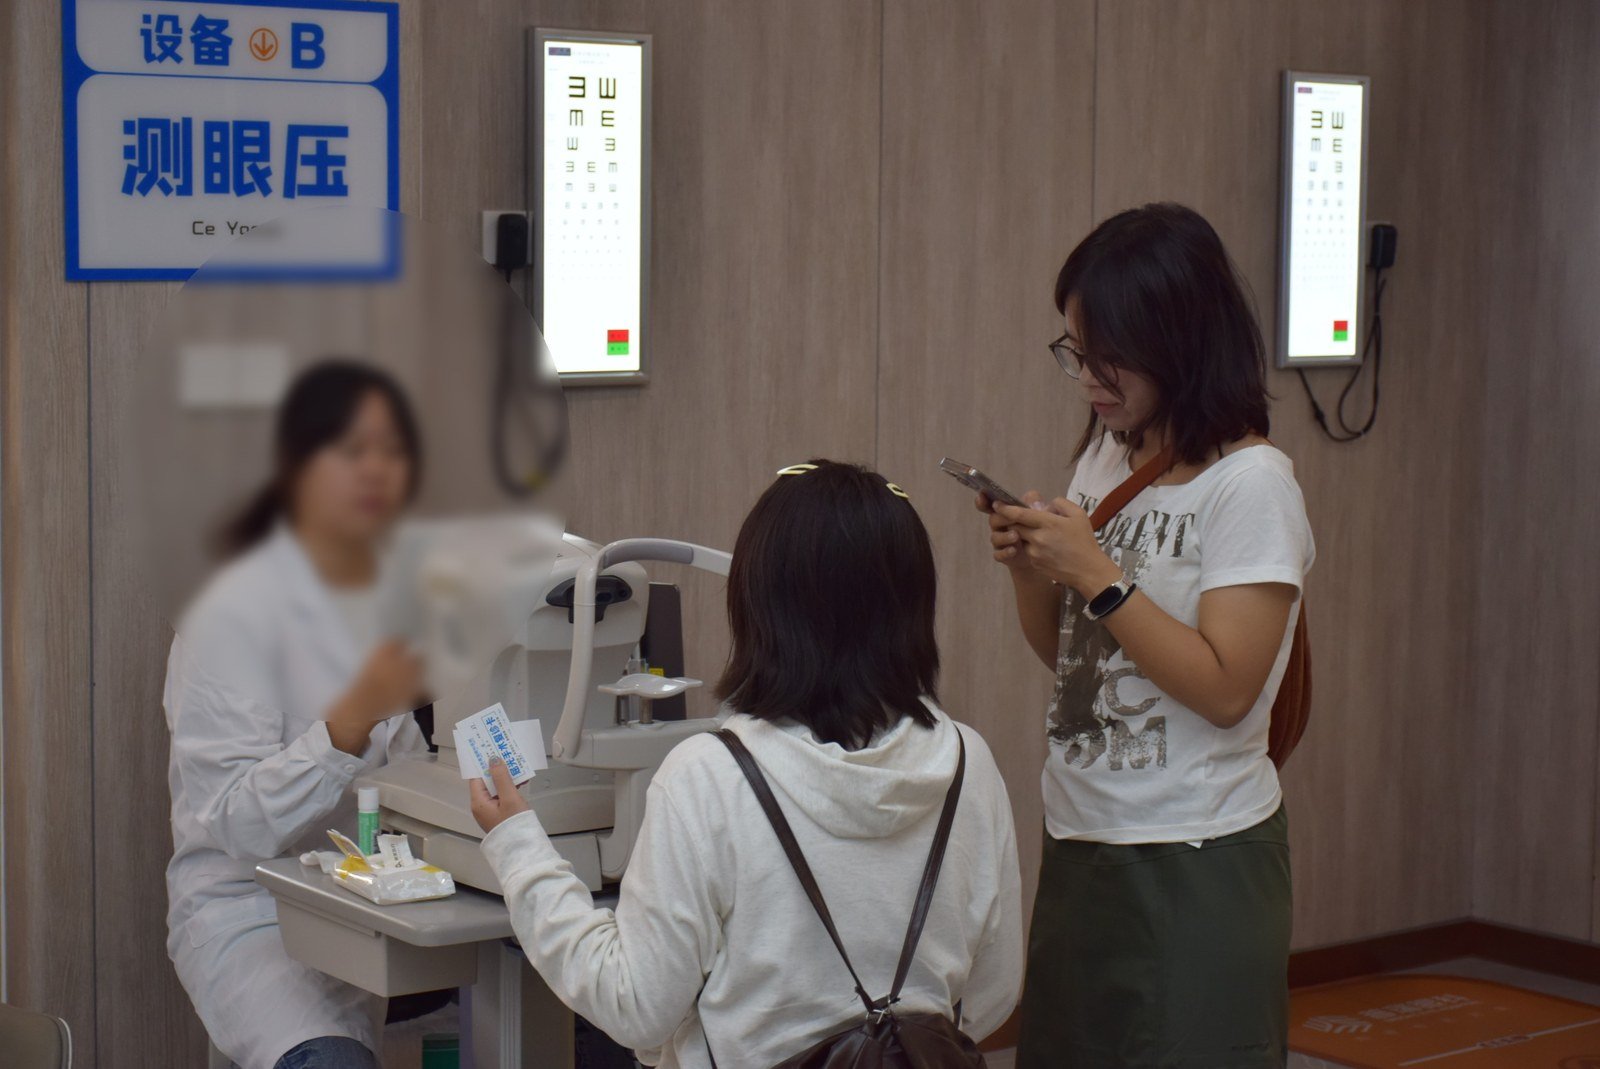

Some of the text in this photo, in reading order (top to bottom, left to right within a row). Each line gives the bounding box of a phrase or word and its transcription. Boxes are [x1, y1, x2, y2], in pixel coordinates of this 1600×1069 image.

[140, 14, 326, 69] 设备 B
[121, 117, 349, 199] 测眼压
[192, 221, 215, 236] Ce
